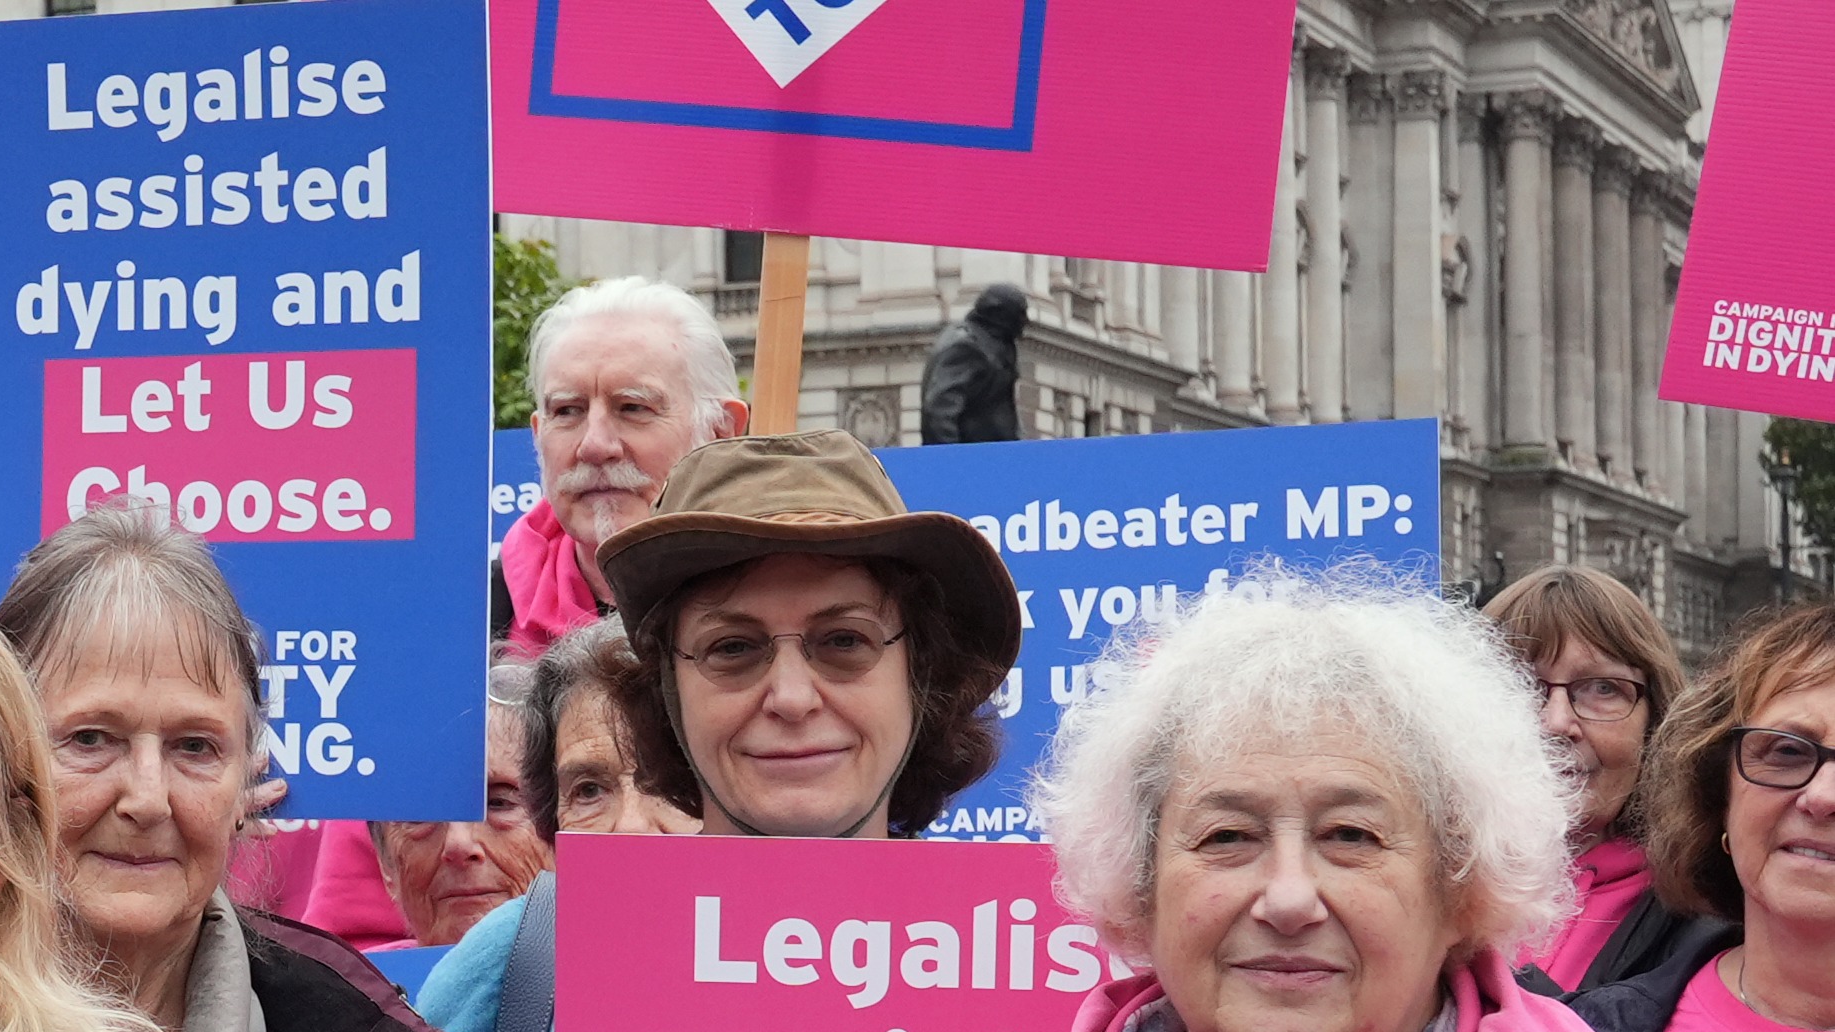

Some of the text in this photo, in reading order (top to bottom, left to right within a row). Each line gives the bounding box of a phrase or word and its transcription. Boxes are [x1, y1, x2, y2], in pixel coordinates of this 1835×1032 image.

[46, 44, 387, 142] Legalise
[45, 146, 388, 234] assisted
[15, 249, 422, 350] dying and
[1713, 299, 1824, 327] CAMPAIGN
[1702, 341, 1742, 371] IN
[81, 359, 354, 434] Let Us
[1286, 484, 1414, 540] MP:
[275, 630, 357, 661] FOR
[693, 895, 1136, 1010] Legalis
